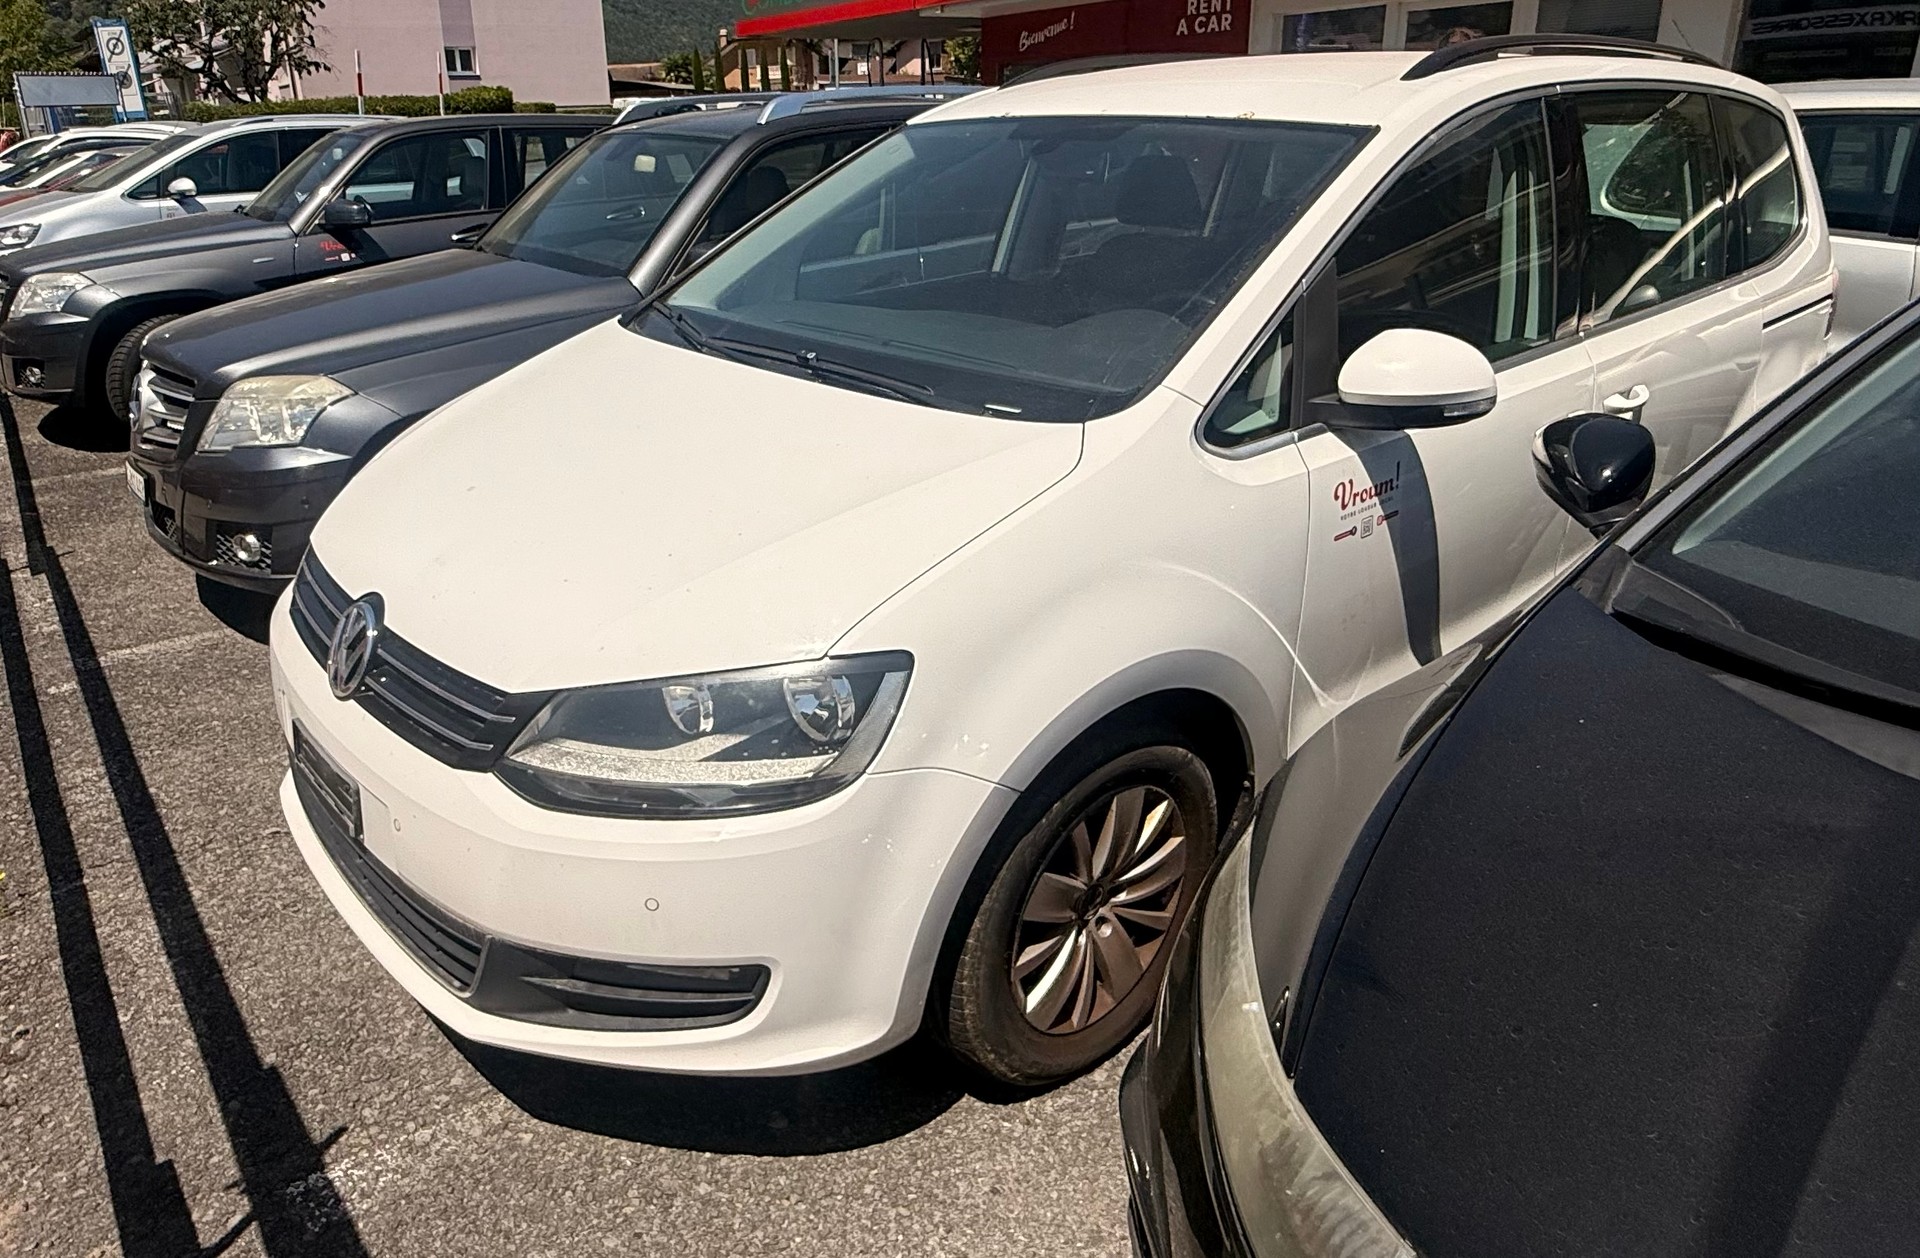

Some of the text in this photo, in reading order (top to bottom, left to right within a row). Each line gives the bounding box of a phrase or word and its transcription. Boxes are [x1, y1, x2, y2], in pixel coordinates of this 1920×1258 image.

[1176, 13, 1232, 36] A CAR
[1333, 461, 1401, 511] Vroum!
